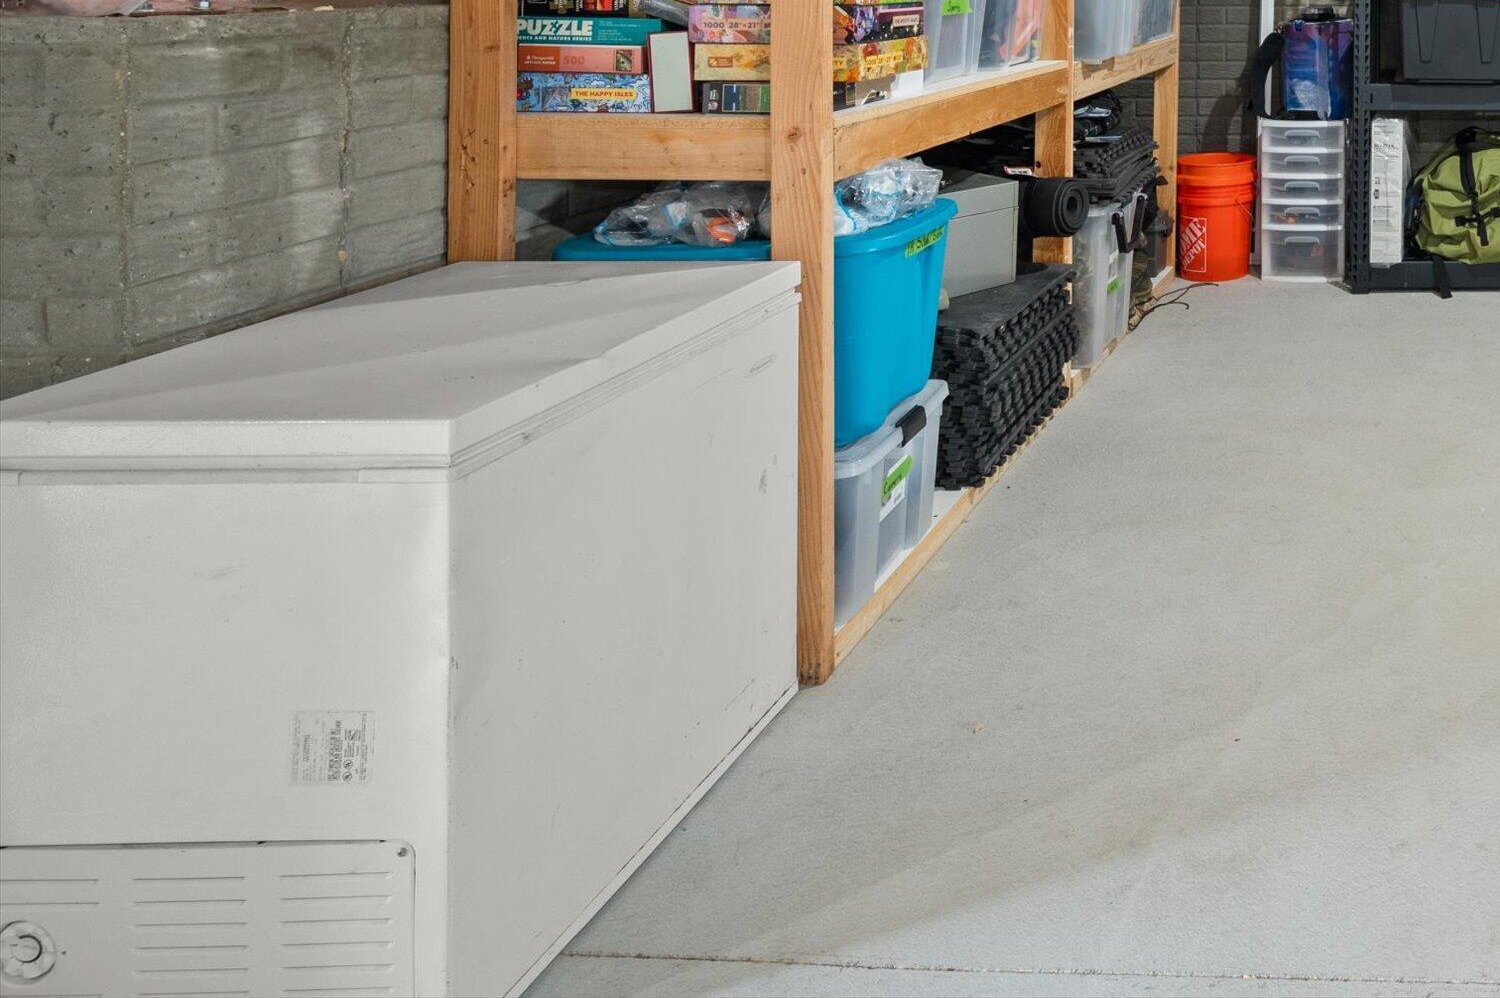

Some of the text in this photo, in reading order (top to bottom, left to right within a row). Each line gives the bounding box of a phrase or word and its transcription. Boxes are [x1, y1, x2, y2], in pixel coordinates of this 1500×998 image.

[517, 19, 594, 36] PUZZLE
[564, 55, 586, 65] 500
[589, 90, 613, 98] HAPPY
[614, 90, 634, 98] ISLES
[1180, 219, 1206, 256] OME
